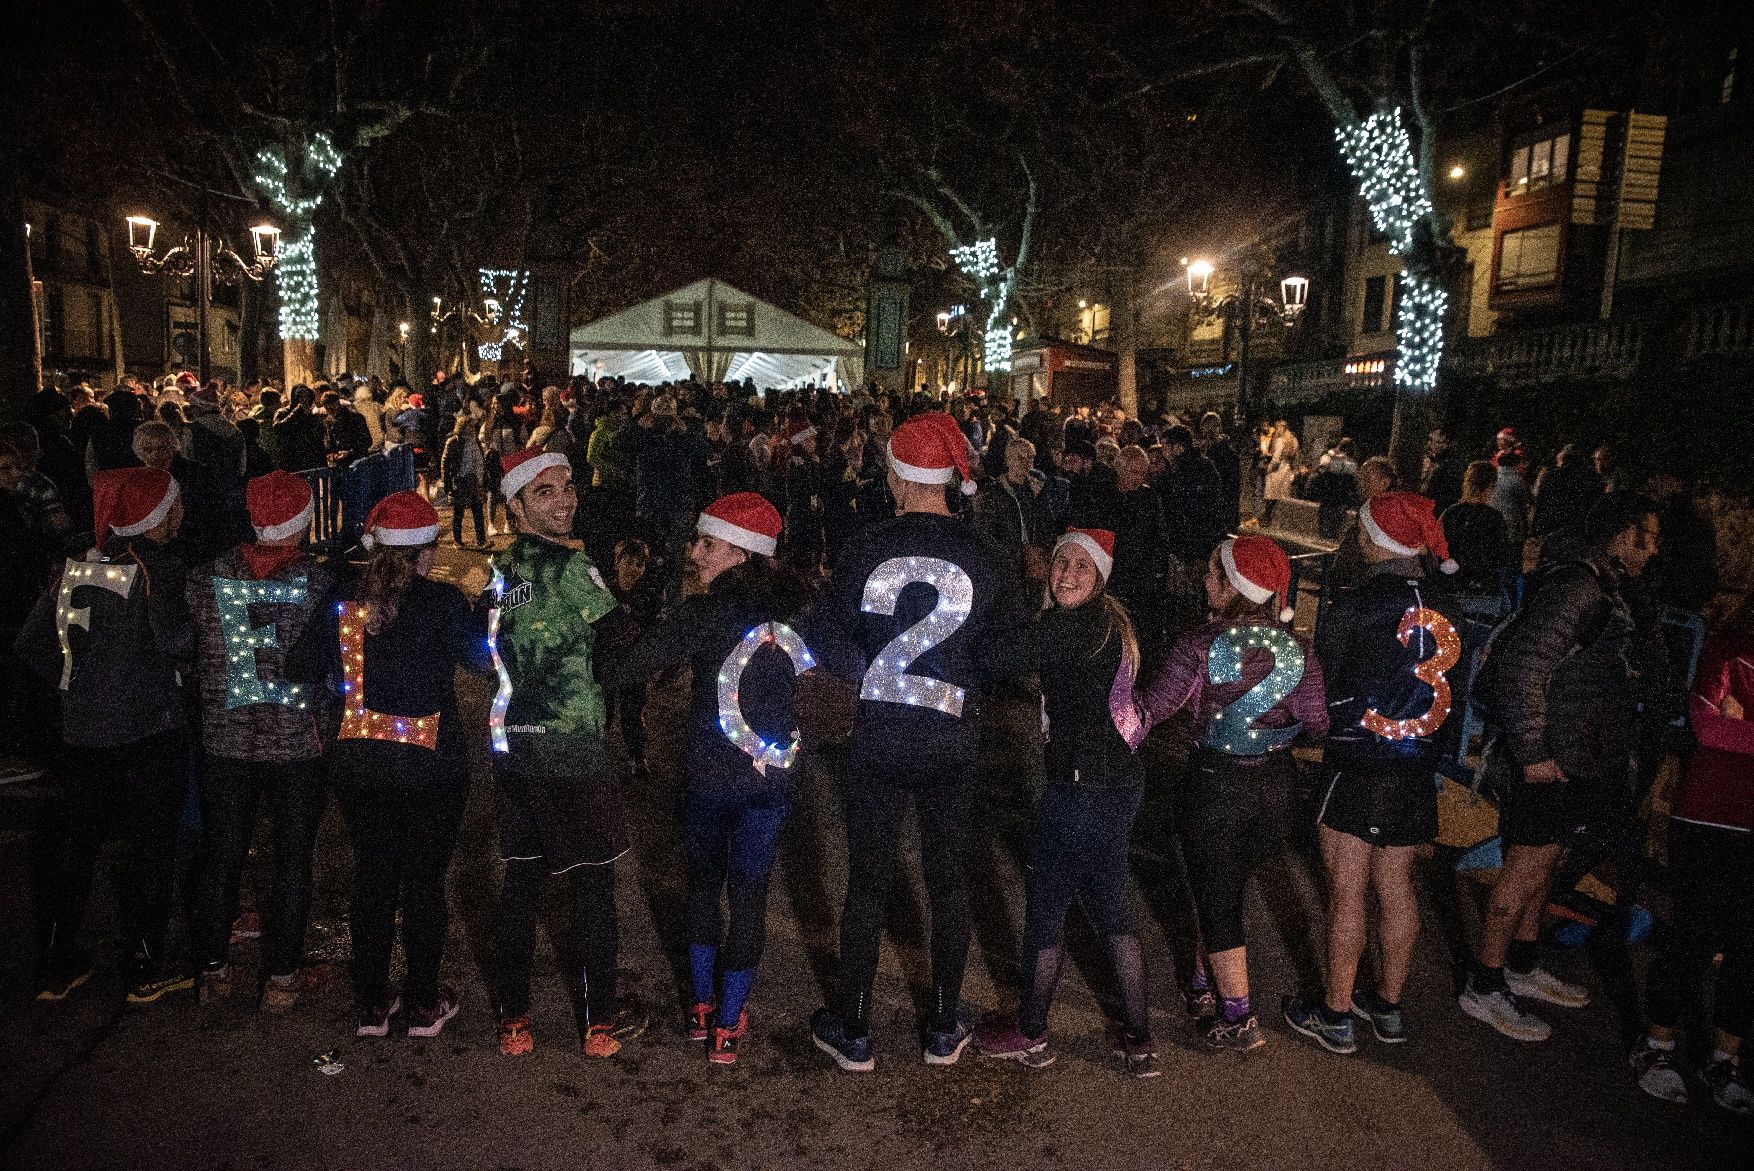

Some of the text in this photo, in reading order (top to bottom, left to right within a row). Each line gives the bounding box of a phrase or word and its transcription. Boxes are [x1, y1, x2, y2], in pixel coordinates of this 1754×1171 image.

[55, 557, 139, 690] F
[212, 575, 308, 711] E
[338, 601, 440, 751] L
[860, 555, 973, 718] 2
[1207, 625, 1305, 756] 2
[1360, 606, 1462, 740] 3
